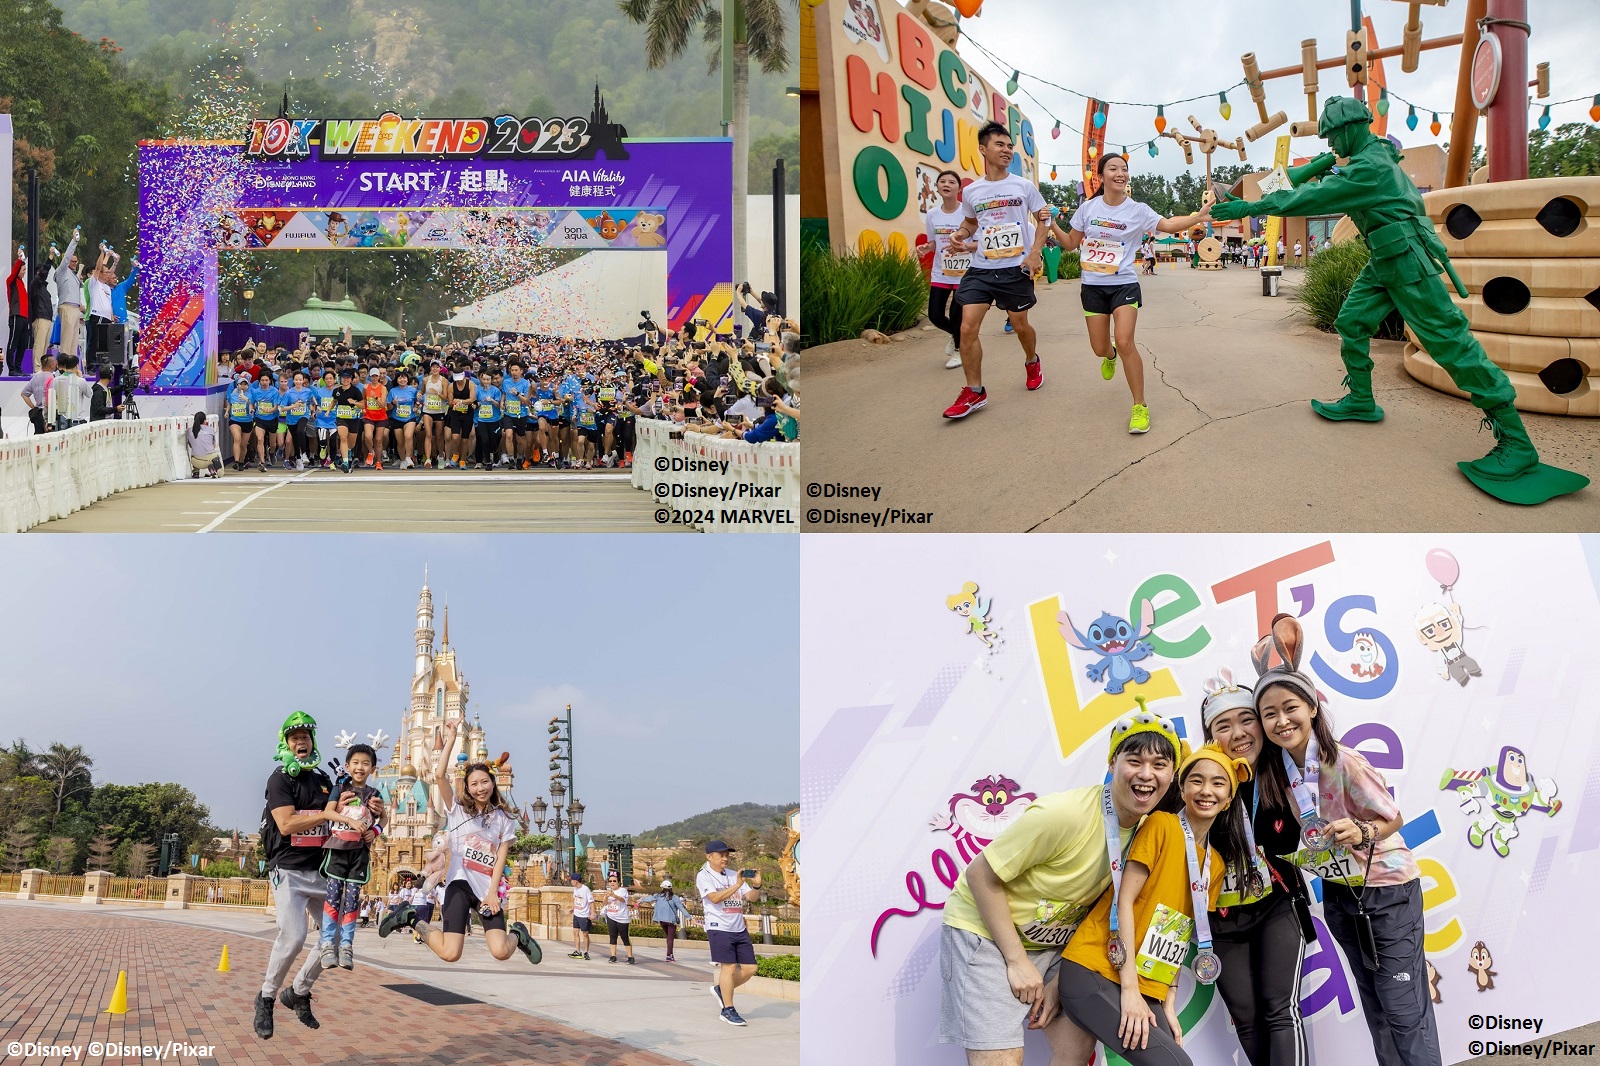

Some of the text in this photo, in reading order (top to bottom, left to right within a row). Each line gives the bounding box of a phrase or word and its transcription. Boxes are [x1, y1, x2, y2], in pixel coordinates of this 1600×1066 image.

[842, 19, 867, 40] AMIGOS
[897, 12, 937, 91] B
[938, 49, 967, 108] C
[1021, 118, 1035, 159] G
[846, 54, 900, 143] H
[901, 84, 935, 156] I
[935, 108, 955, 163] J
[248, 117, 589, 155] 10K WEEKEND 2023
[359, 172, 435, 191] START
[459, 169, 509, 193] 起點
[561, 167, 626, 186] AIA Vitality
[853, 145, 909, 220] O
[568, 184, 616, 198] 健康程式
[563, 225, 582, 234] bon
[564, 233, 589, 241] aqua
[984, 232, 1019, 250] 2137
[943, 258, 971, 270] 10272
[1086, 249, 1116, 264] 273
[1104, 788, 1113, 816] PIXAR
[464, 847, 496, 867] E8262
